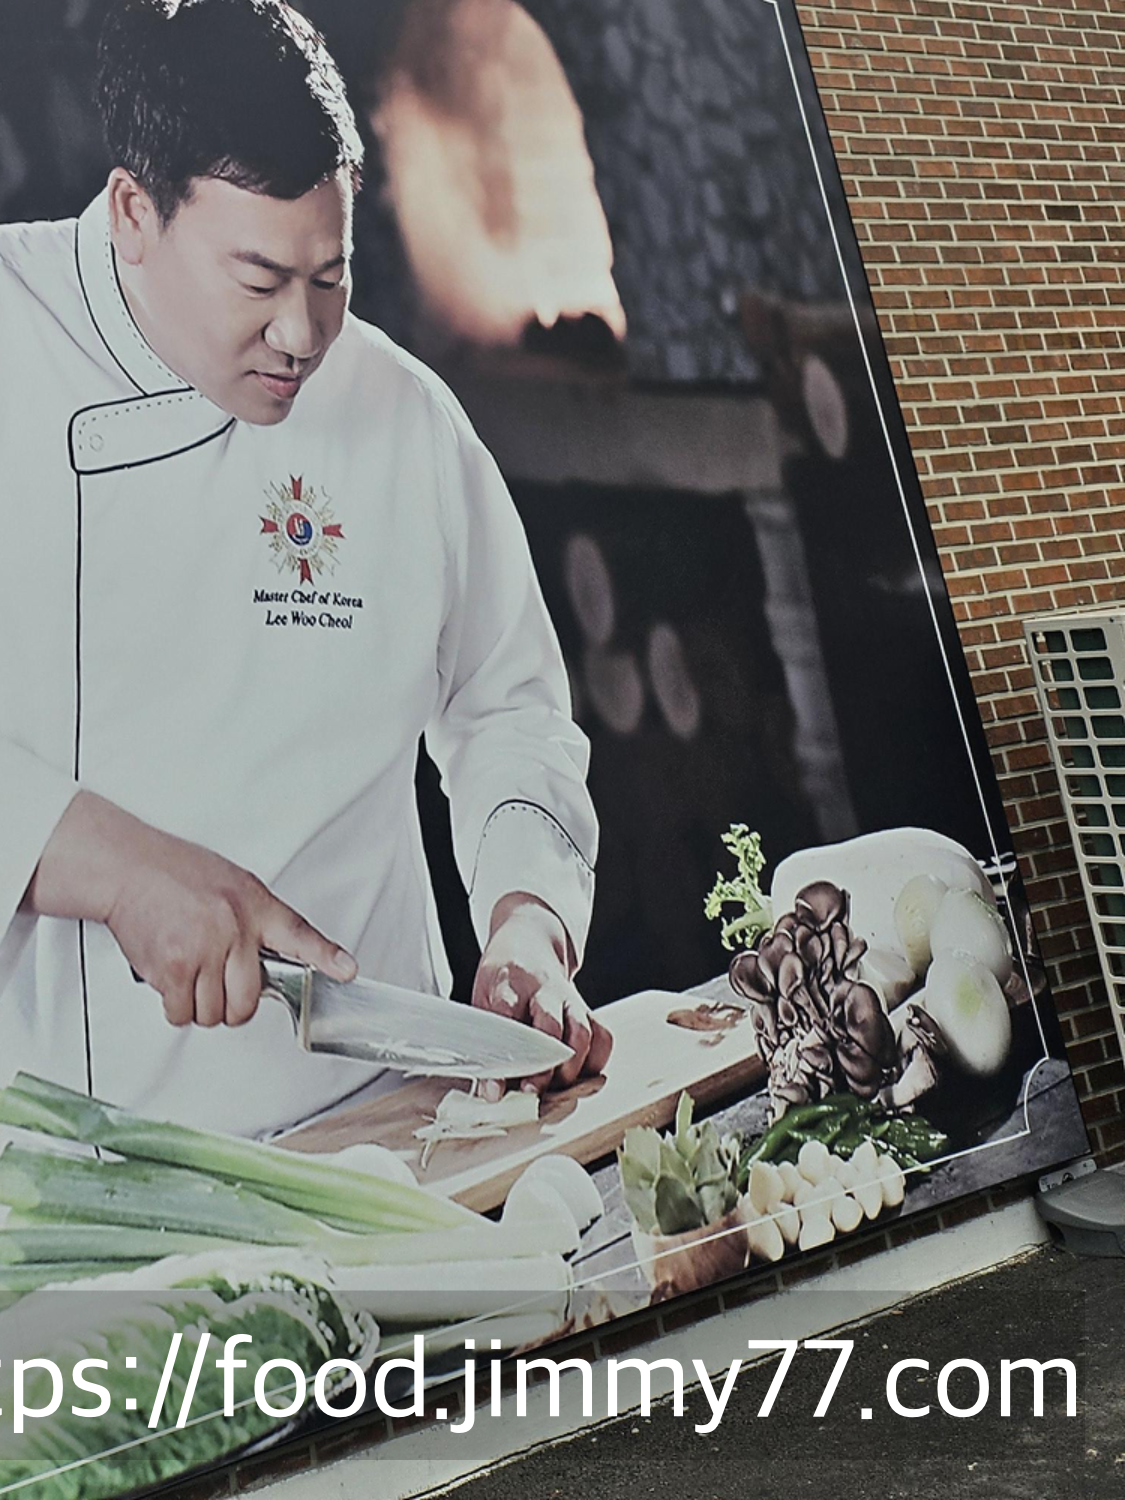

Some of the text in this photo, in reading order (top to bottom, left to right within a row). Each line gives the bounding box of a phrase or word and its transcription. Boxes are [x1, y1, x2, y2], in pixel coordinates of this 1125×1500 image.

[253, 589, 363, 608] Master Chef of Korea
[265, 610, 353, 629] Lee Woo Cheol
